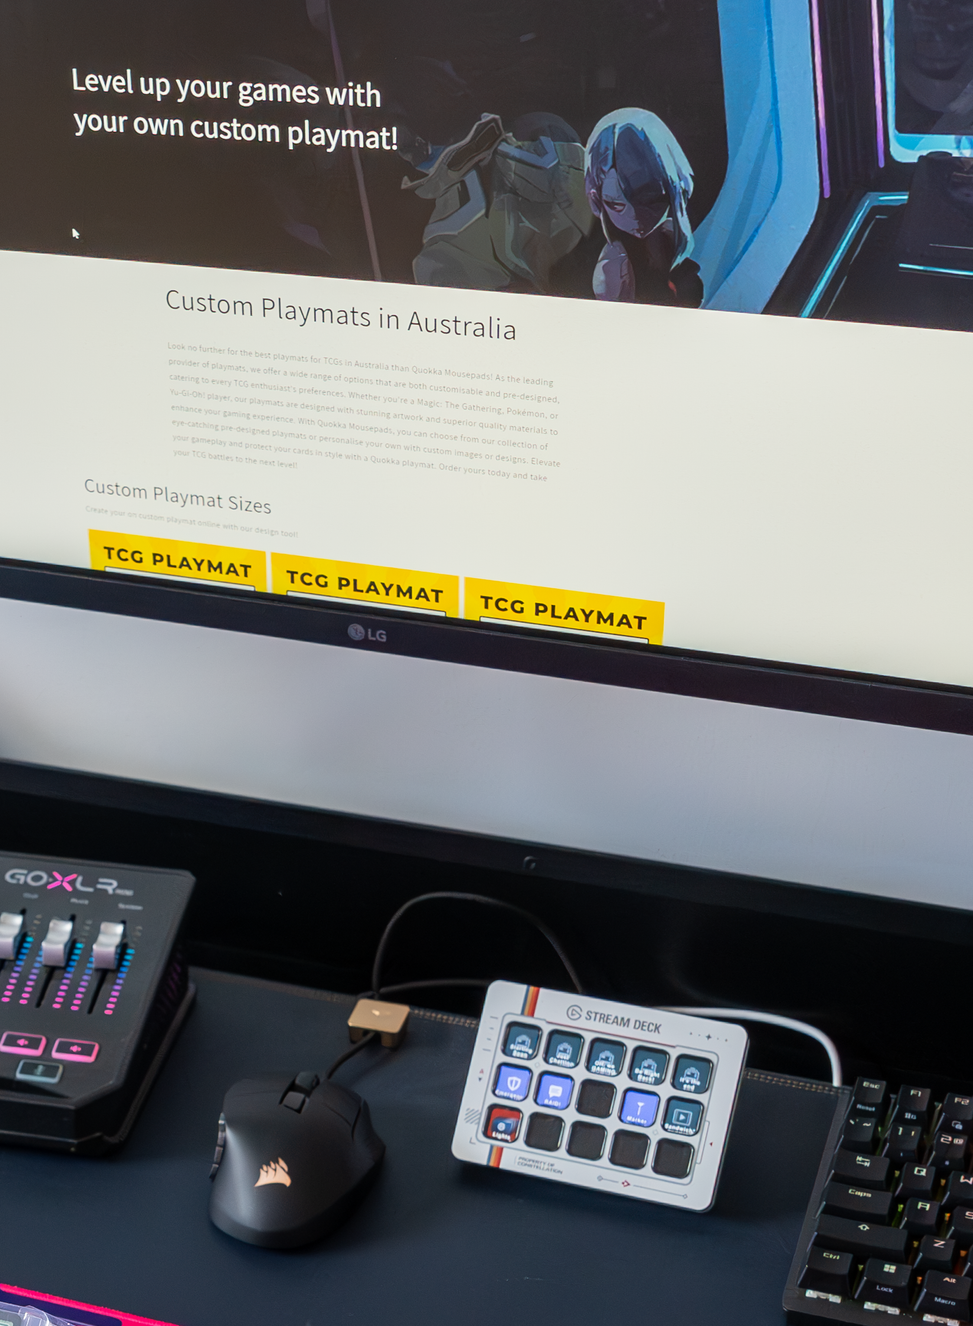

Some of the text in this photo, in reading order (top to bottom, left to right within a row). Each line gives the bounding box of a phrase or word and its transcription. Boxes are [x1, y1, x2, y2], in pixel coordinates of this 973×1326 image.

[71, 67, 381, 107] Level up your games with
[72, 112, 398, 153] your own custom playmat!
[165, 288, 516, 340] Custom Playmats in Australia
[83, 477, 272, 514] Custom Playmat Sizes
[102, 545, 252, 578] TCG PLAYMAT
[285, 569, 443, 603] TCG PLAYMAT
[479, 594, 647, 630] TCG PLAYMAT
[367, 628, 387, 642] LG
[585, 1010, 662, 1034] STREAM DECK
[863, 1081, 880, 1090] Esc
[913, 1166, 927, 1177] Q
[848, 1188, 872, 1198] Caps
[823, 1252, 841, 1260] Ctrl
[876, 1284, 894, 1294] Lock
[943, 1276, 957, 1284] Alt
[934, 1296, 956, 1306] Macro
